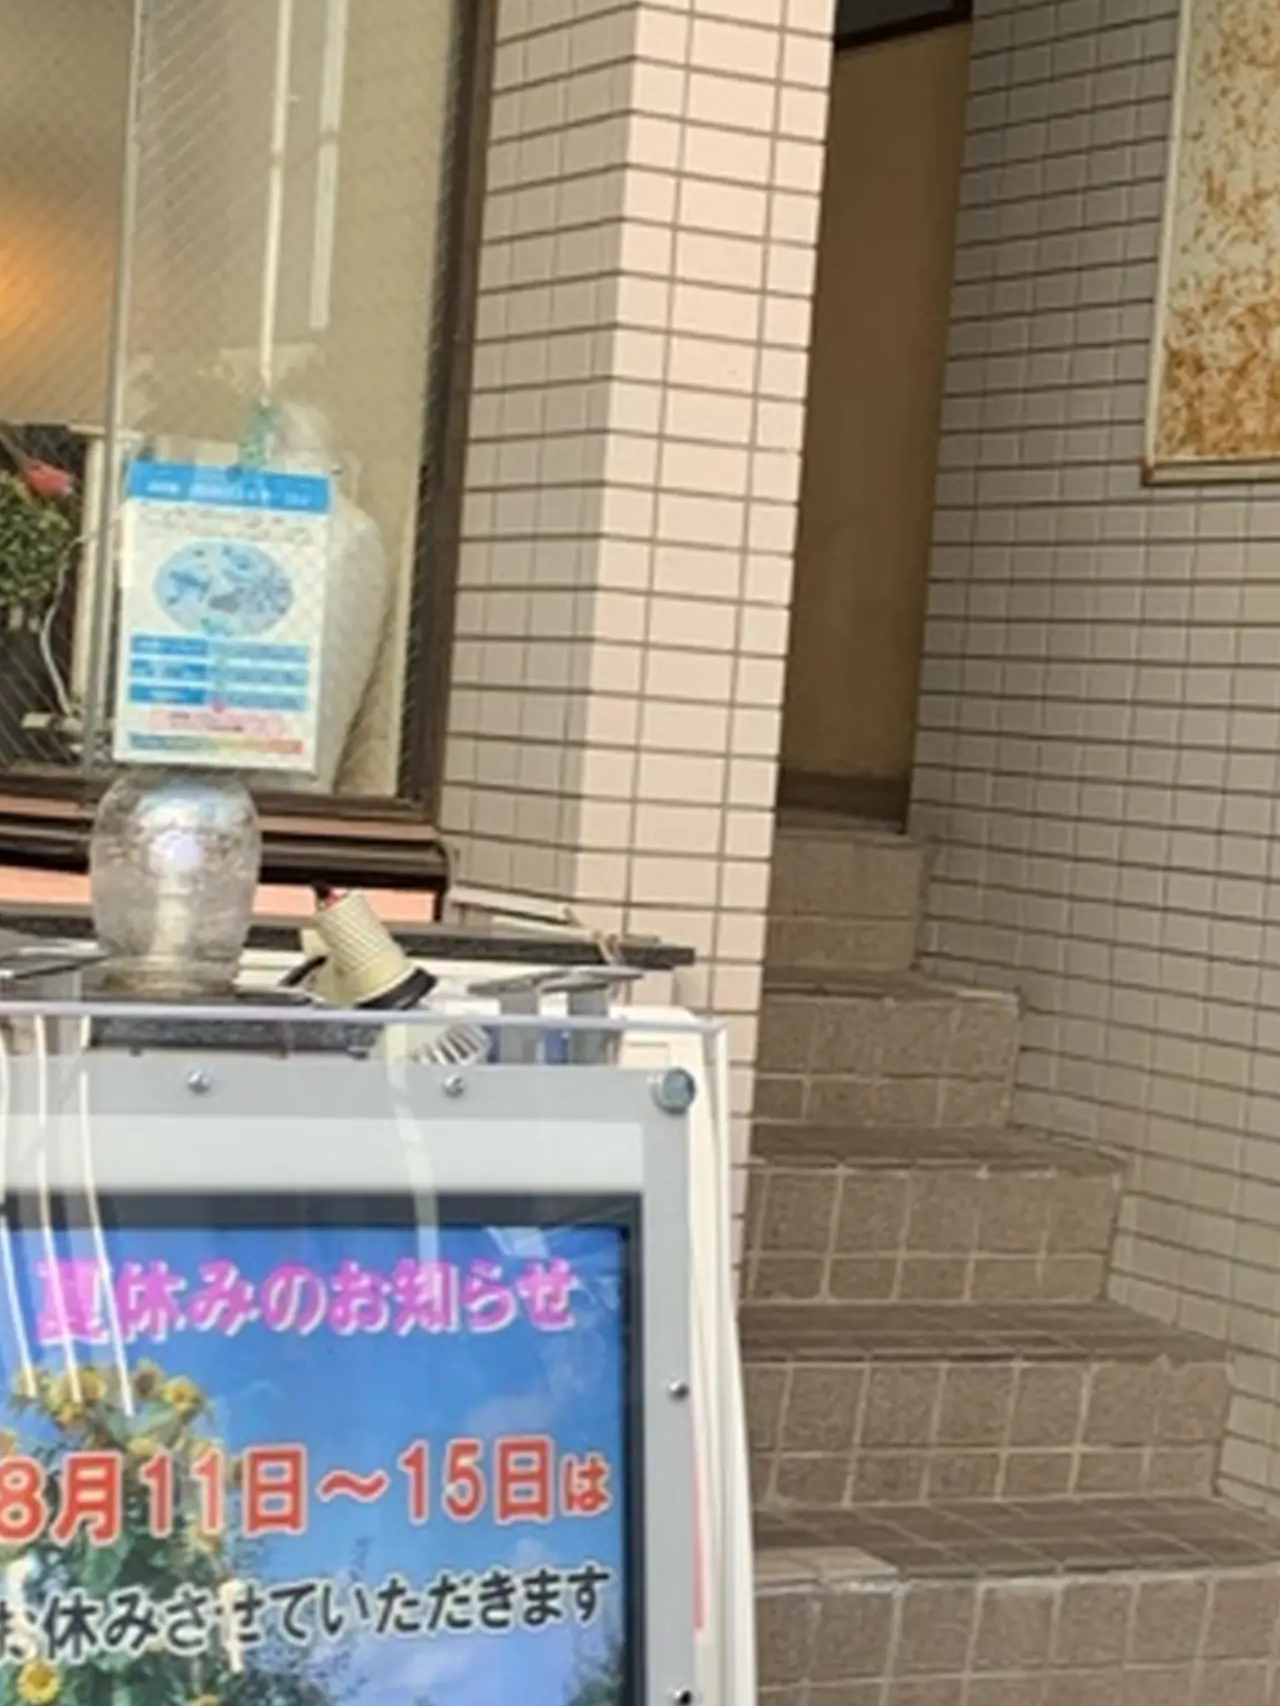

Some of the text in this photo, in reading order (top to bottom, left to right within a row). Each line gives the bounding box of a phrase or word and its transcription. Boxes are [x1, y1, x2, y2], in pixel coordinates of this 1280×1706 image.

[37, 1255, 579, 1346] 夏休みのお知らせ
